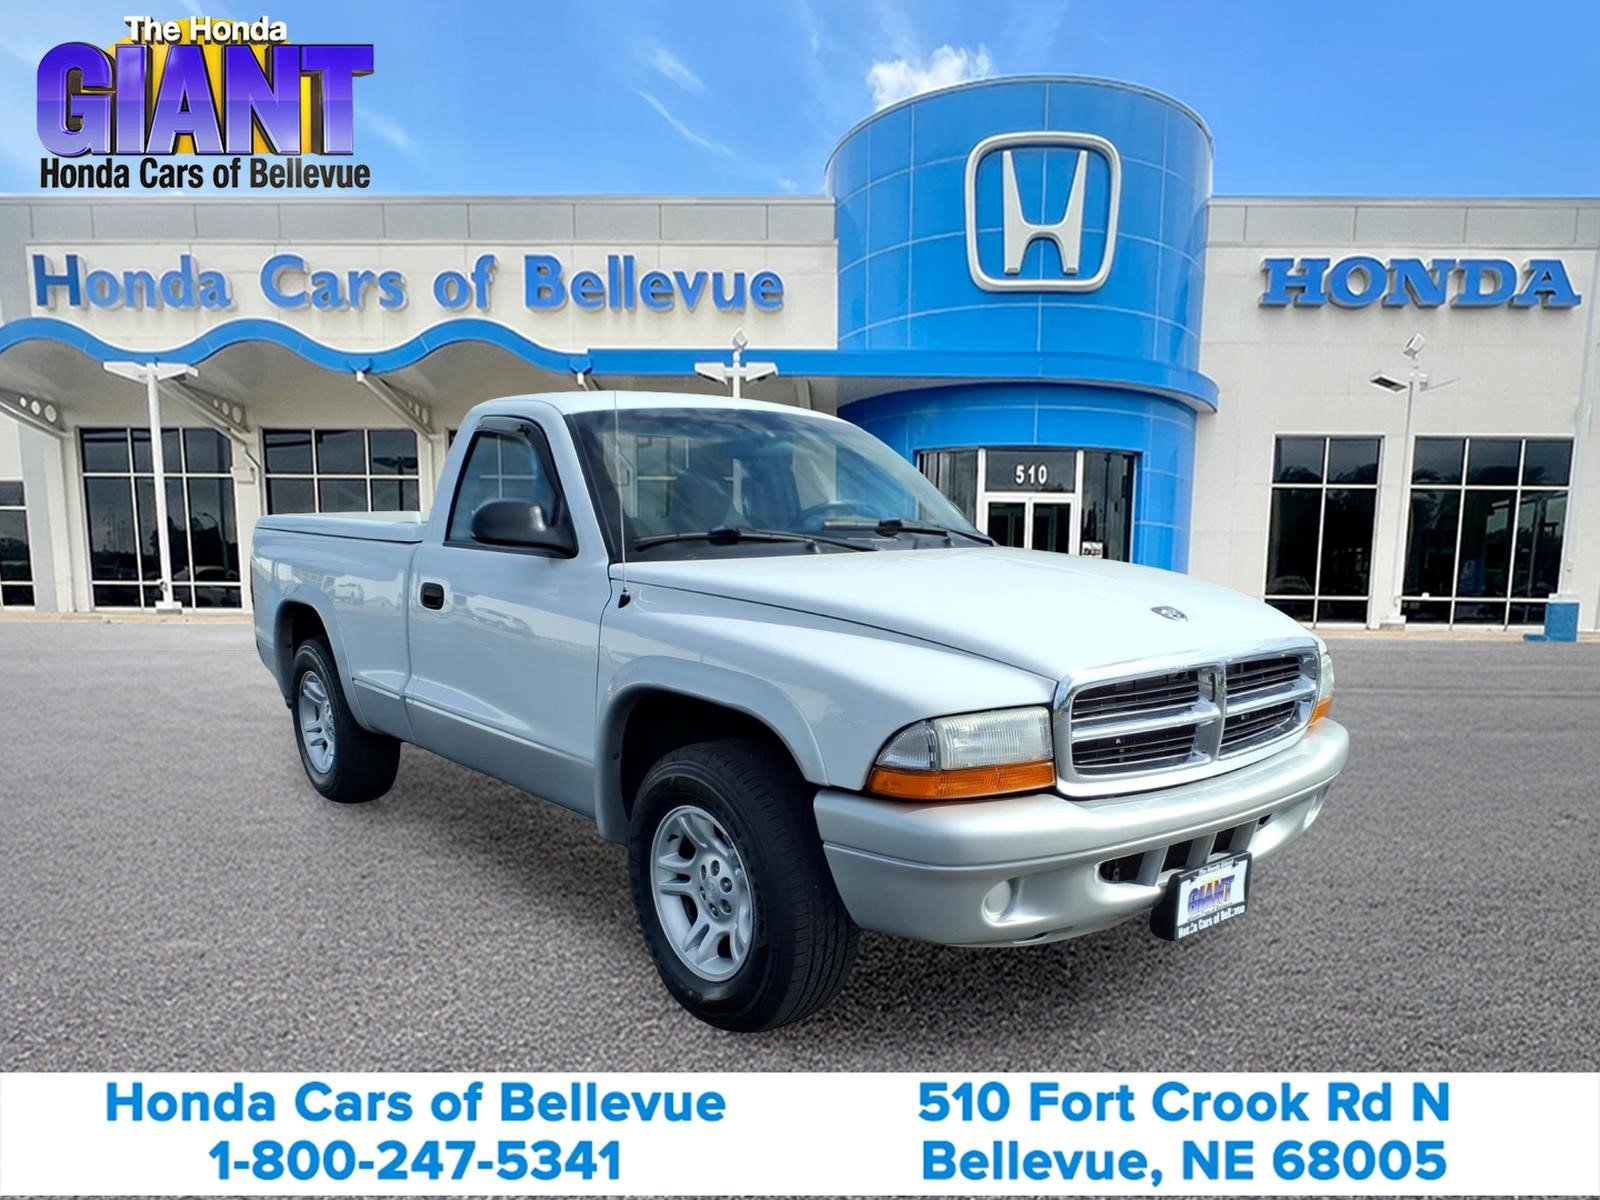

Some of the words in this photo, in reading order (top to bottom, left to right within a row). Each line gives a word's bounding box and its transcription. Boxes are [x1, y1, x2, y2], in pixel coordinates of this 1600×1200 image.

[31, 254, 232, 310] Honda
[259, 254, 407, 310] Cars
[433, 254, 496, 310] of
[524, 254, 785, 310] Bellevue
[1258, 255, 1582, 309] HONDA
[1014, 464, 1048, 485] 510
[1187, 875, 1236, 914] GIANT
